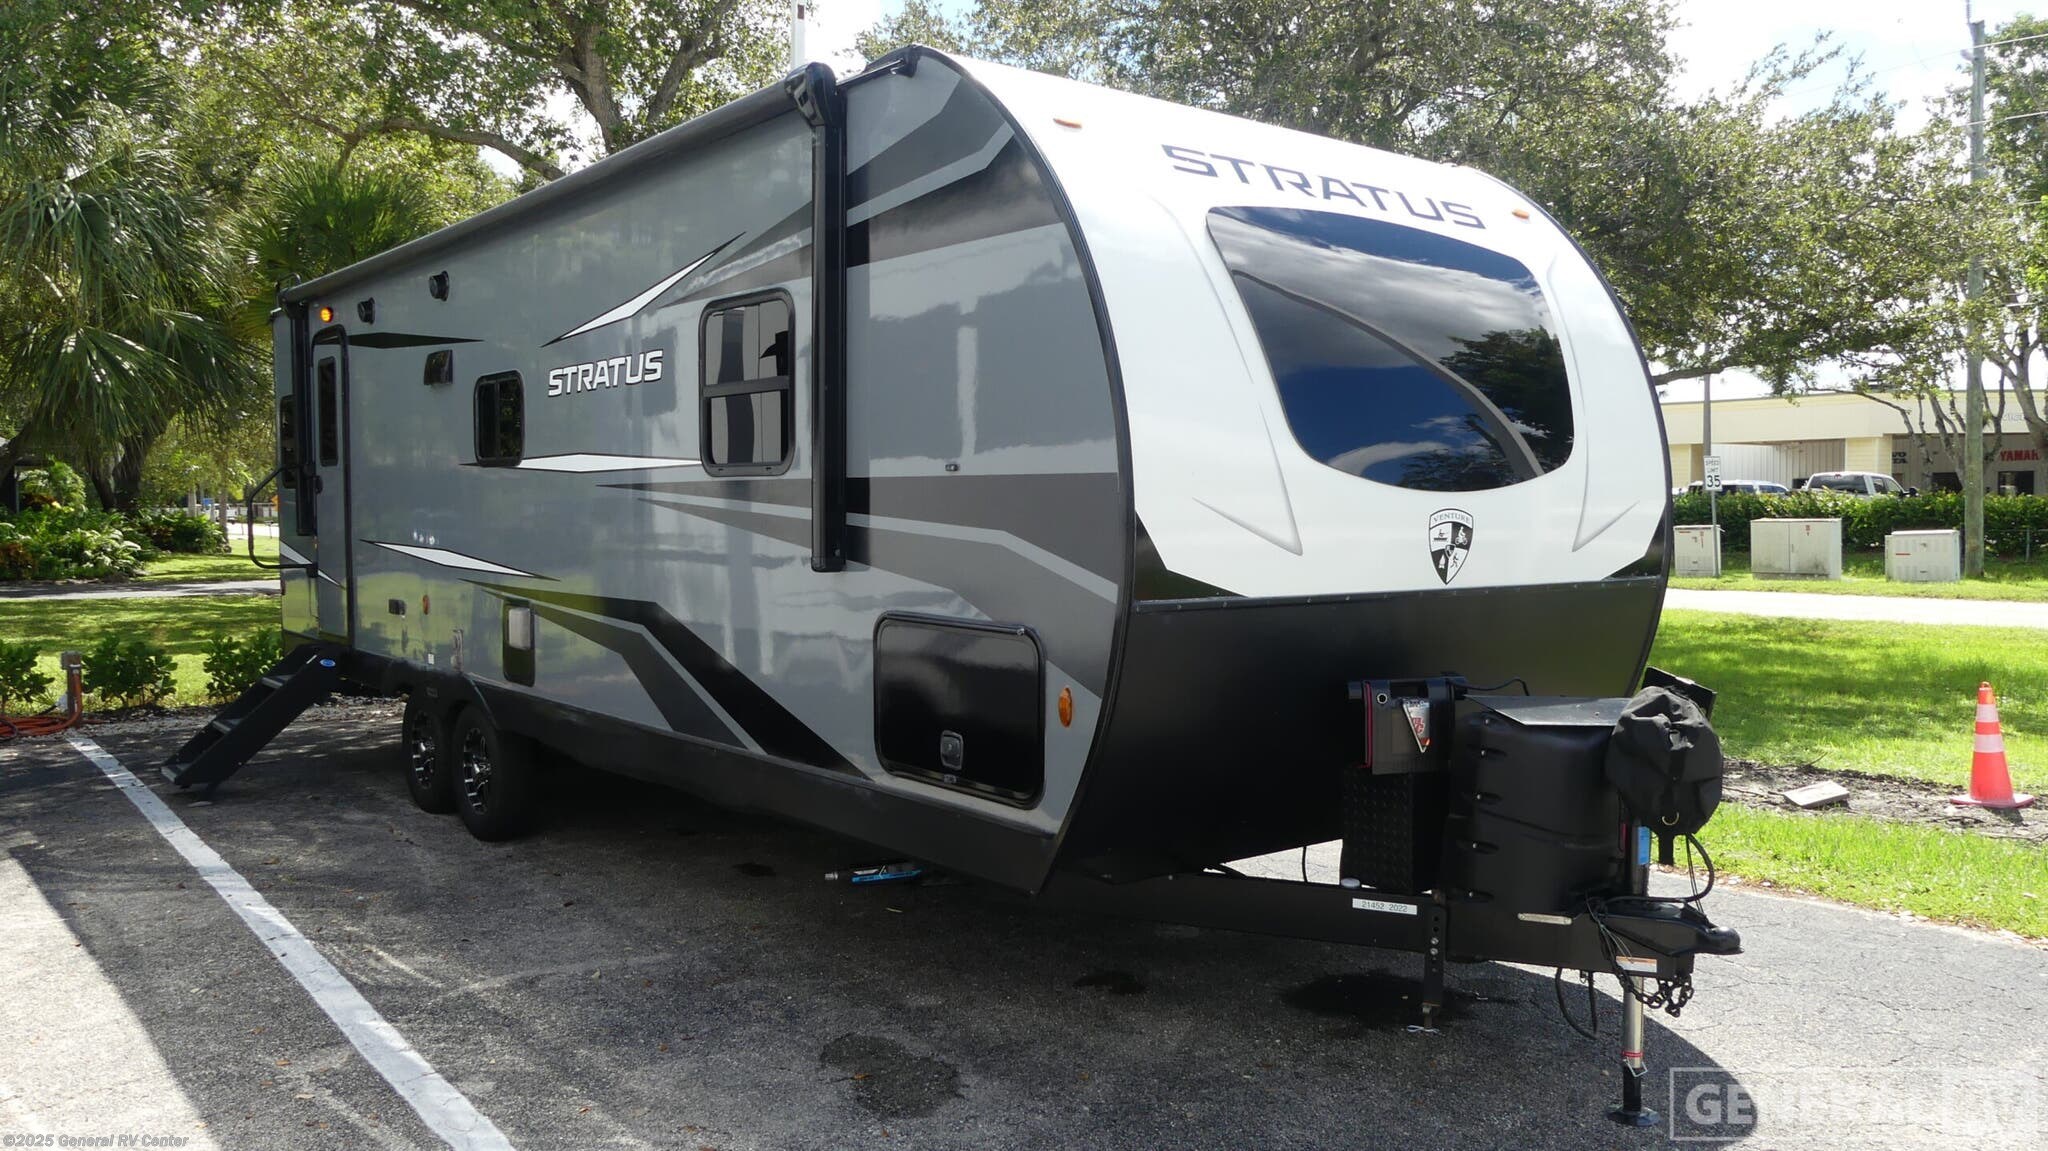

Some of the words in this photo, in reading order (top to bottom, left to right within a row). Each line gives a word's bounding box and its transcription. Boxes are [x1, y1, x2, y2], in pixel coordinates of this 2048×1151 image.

[1161, 144, 1486, 229] STRATUS
[548, 349, 664, 397] STRATUS
[2000, 449, 2040, 462] YAMAH
[1707, 475, 1720, 487] 35
[1433, 513, 1470, 523] VENTURE
[1361, 901, 1385, 910] 21452
[1388, 904, 1408, 912] 2022
